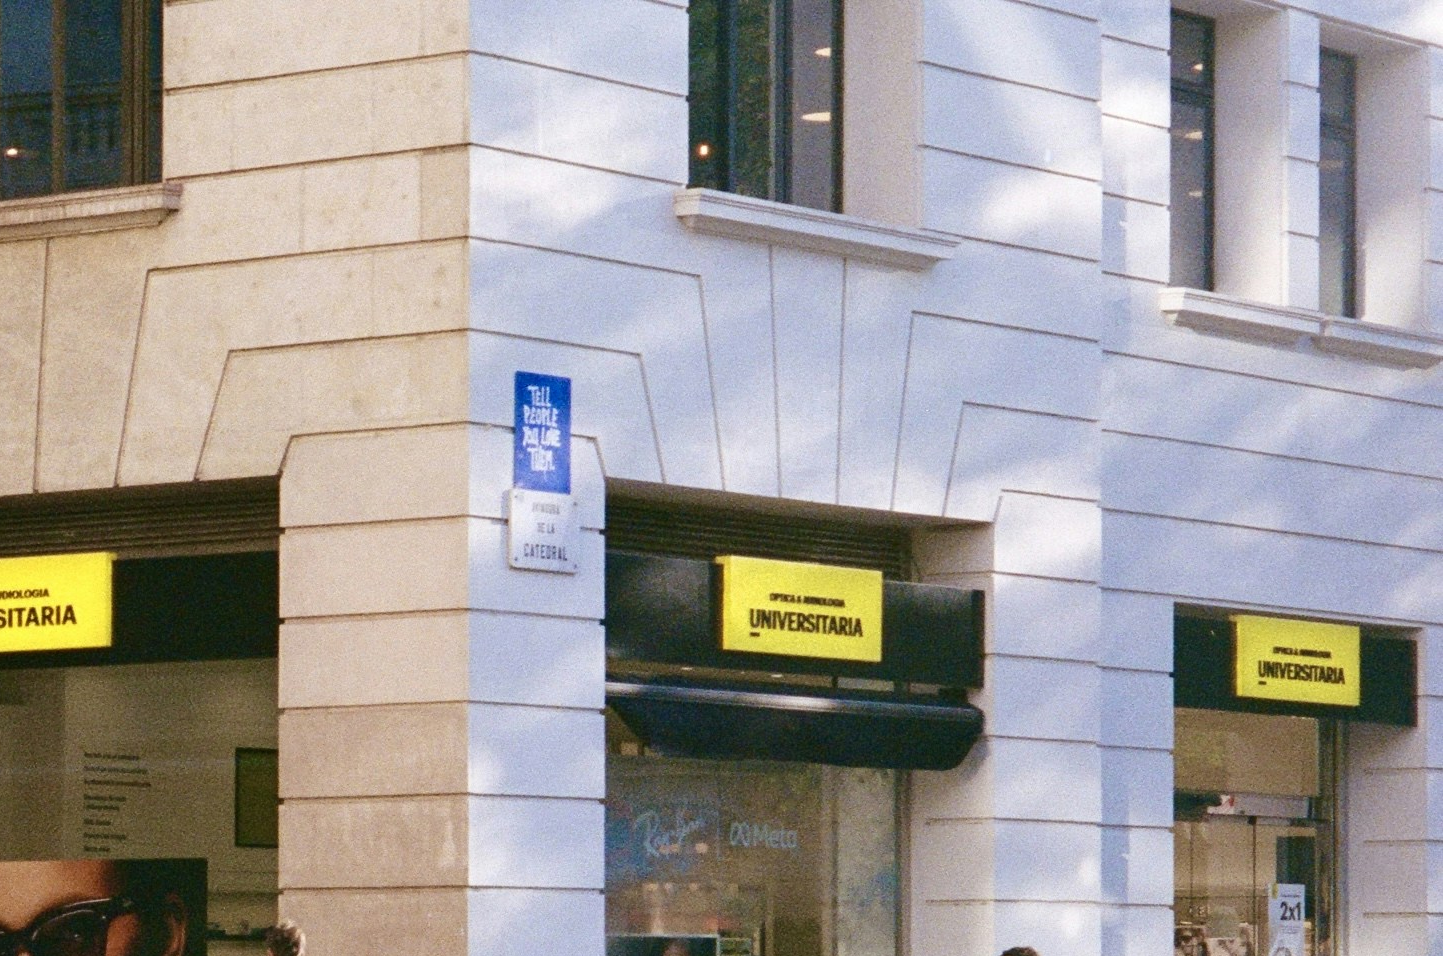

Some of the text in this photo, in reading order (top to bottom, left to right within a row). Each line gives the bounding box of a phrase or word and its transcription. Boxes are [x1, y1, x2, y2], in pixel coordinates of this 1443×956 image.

[524, 543, 568, 562] CATEDRAL
[749, 608, 863, 637] UNIVERSITARIA
[1258, 660, 1345, 685] UNIVERSITARIA
[753, 823, 798, 849] Meta
[1280, 901, 1301, 921] 2x1
